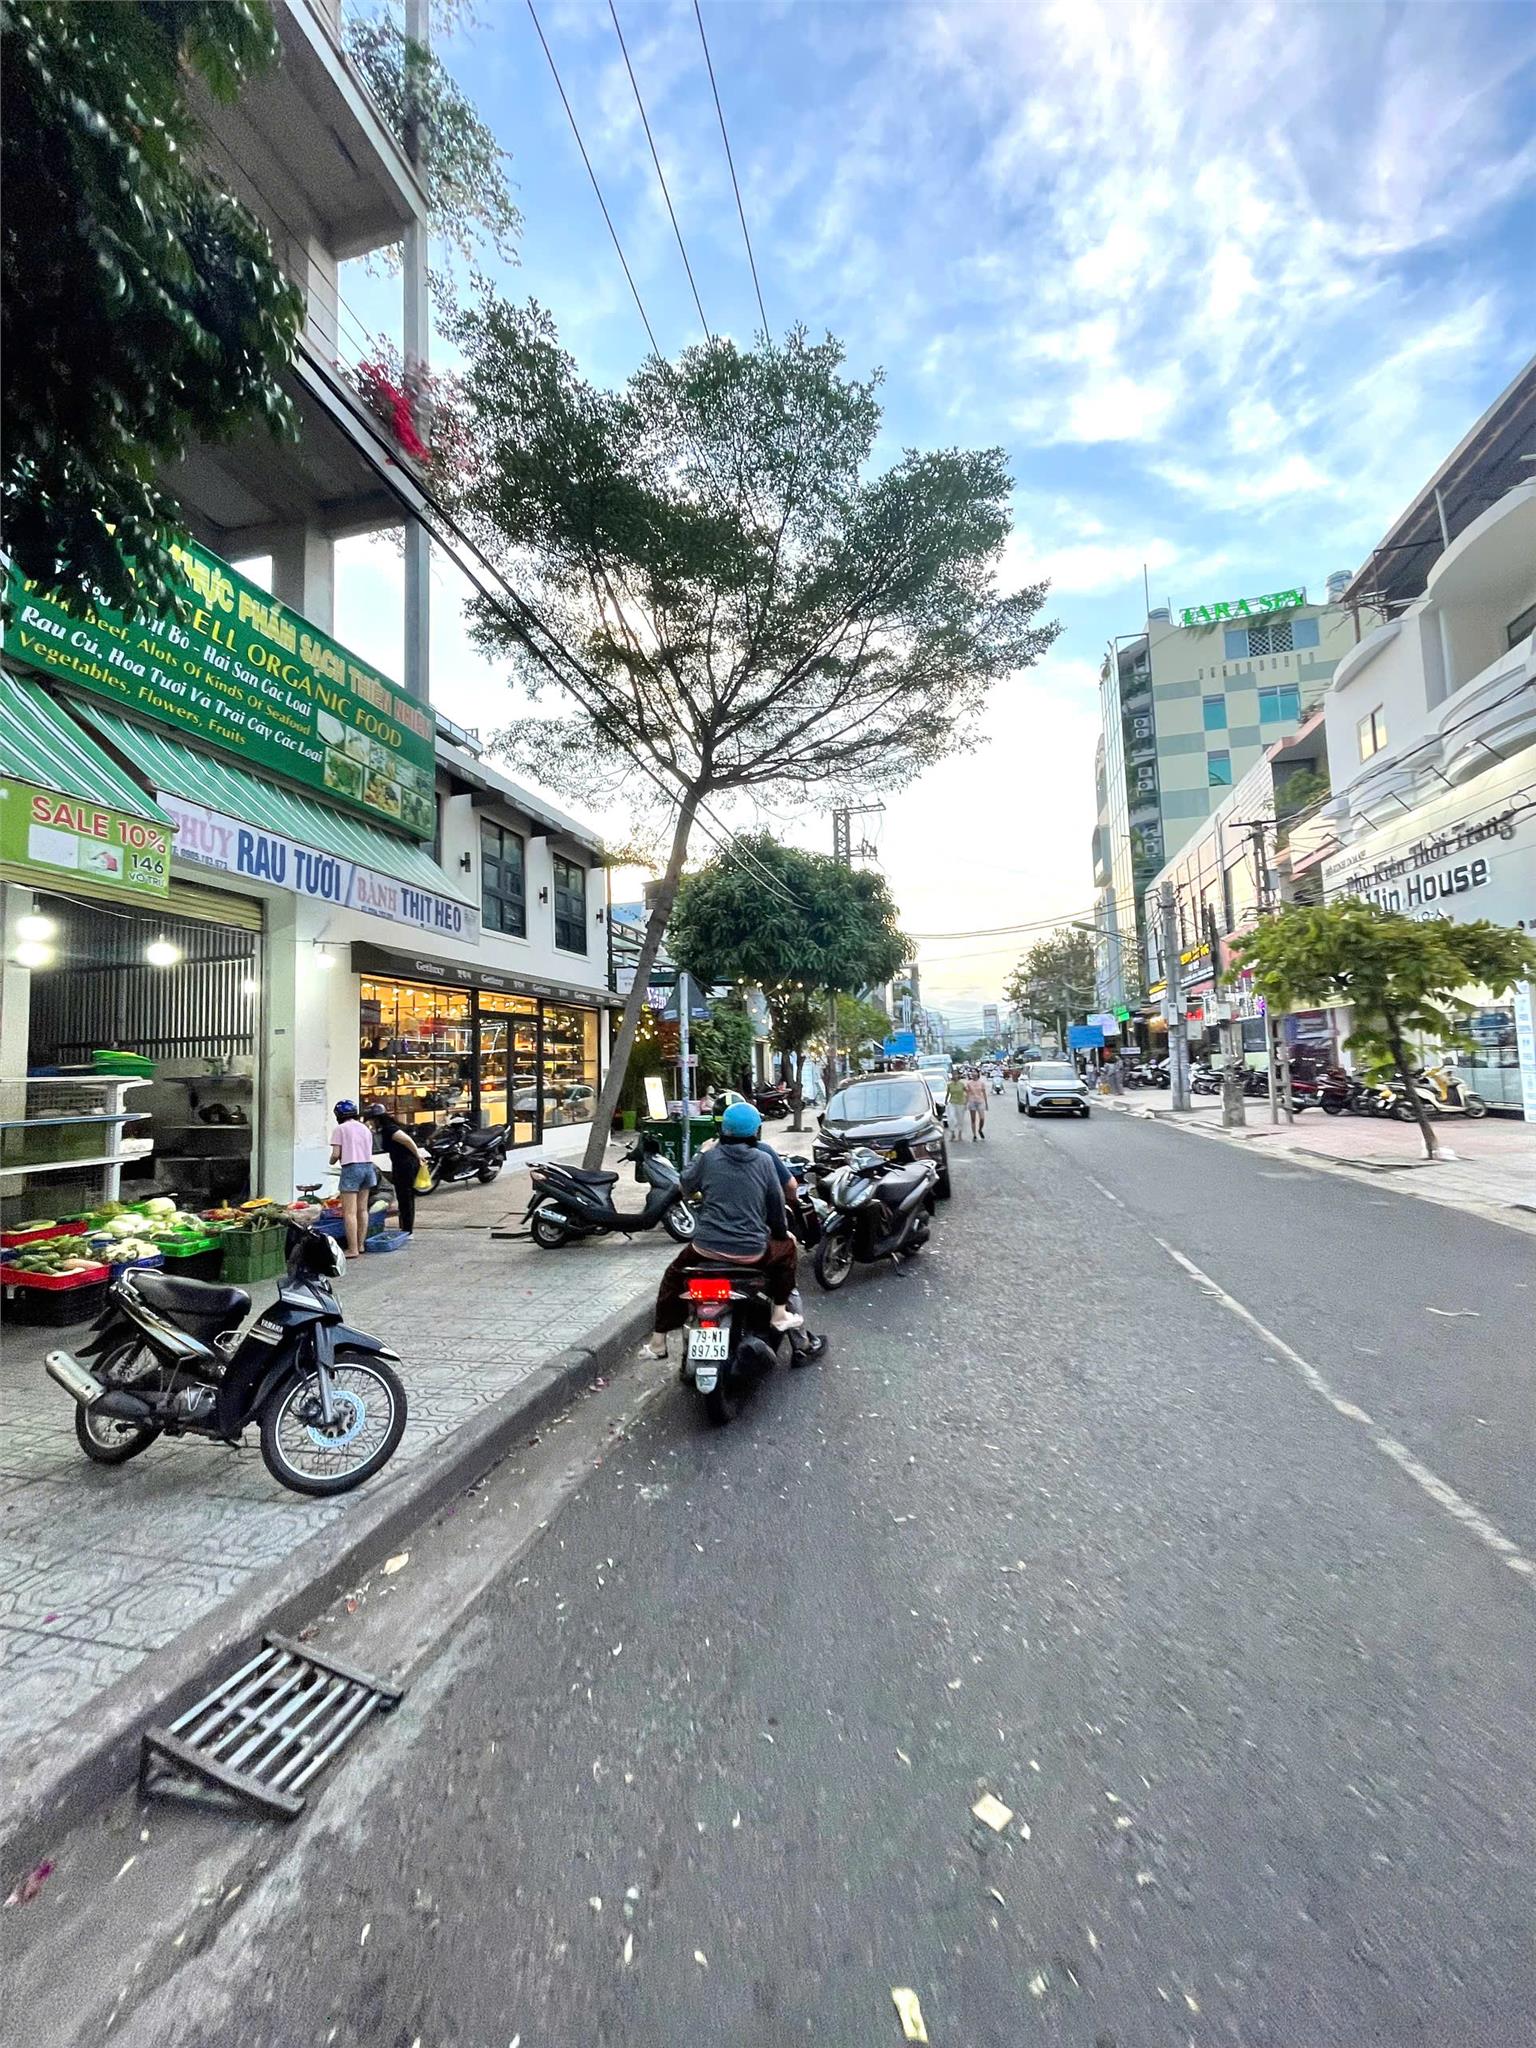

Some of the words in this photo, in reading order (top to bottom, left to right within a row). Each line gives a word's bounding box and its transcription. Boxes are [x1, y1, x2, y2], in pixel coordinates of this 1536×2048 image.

[1183, 599, 1251, 625] TARA
[19, 629, 131, 694] Vegetables,
[138, 686, 203, 728] Flowers,
[208, 718, 247, 745] Fruits
[21, 605, 67, 640] Rau
[108, 646, 146, 677] Hoa
[190, 686, 212, 709] Và
[137, 639, 178, 668] Alots
[183, 661, 203, 679] Of
[247, 694, 264, 711] Of
[265, 704, 312, 736] Seafood
[168, 624, 190, 649] Bò
[261, 678, 285, 702] Các
[247, 643, 352, 719] ORGANIC
[355, 708, 402, 748] FOOD
[32, 796, 110, 839] SALE
[118, 820, 167, 856] 10%
[131, 853, 164, 875] 146
[237, 828, 287, 884] RAU
[294, 849, 341, 901] TƯƠI
[401, 887, 433, 928] THỊT
[434, 899, 462, 933] HEO
[1406, 858, 1488, 907] House
[261, 1318, 284, 1334] YAMAHA
